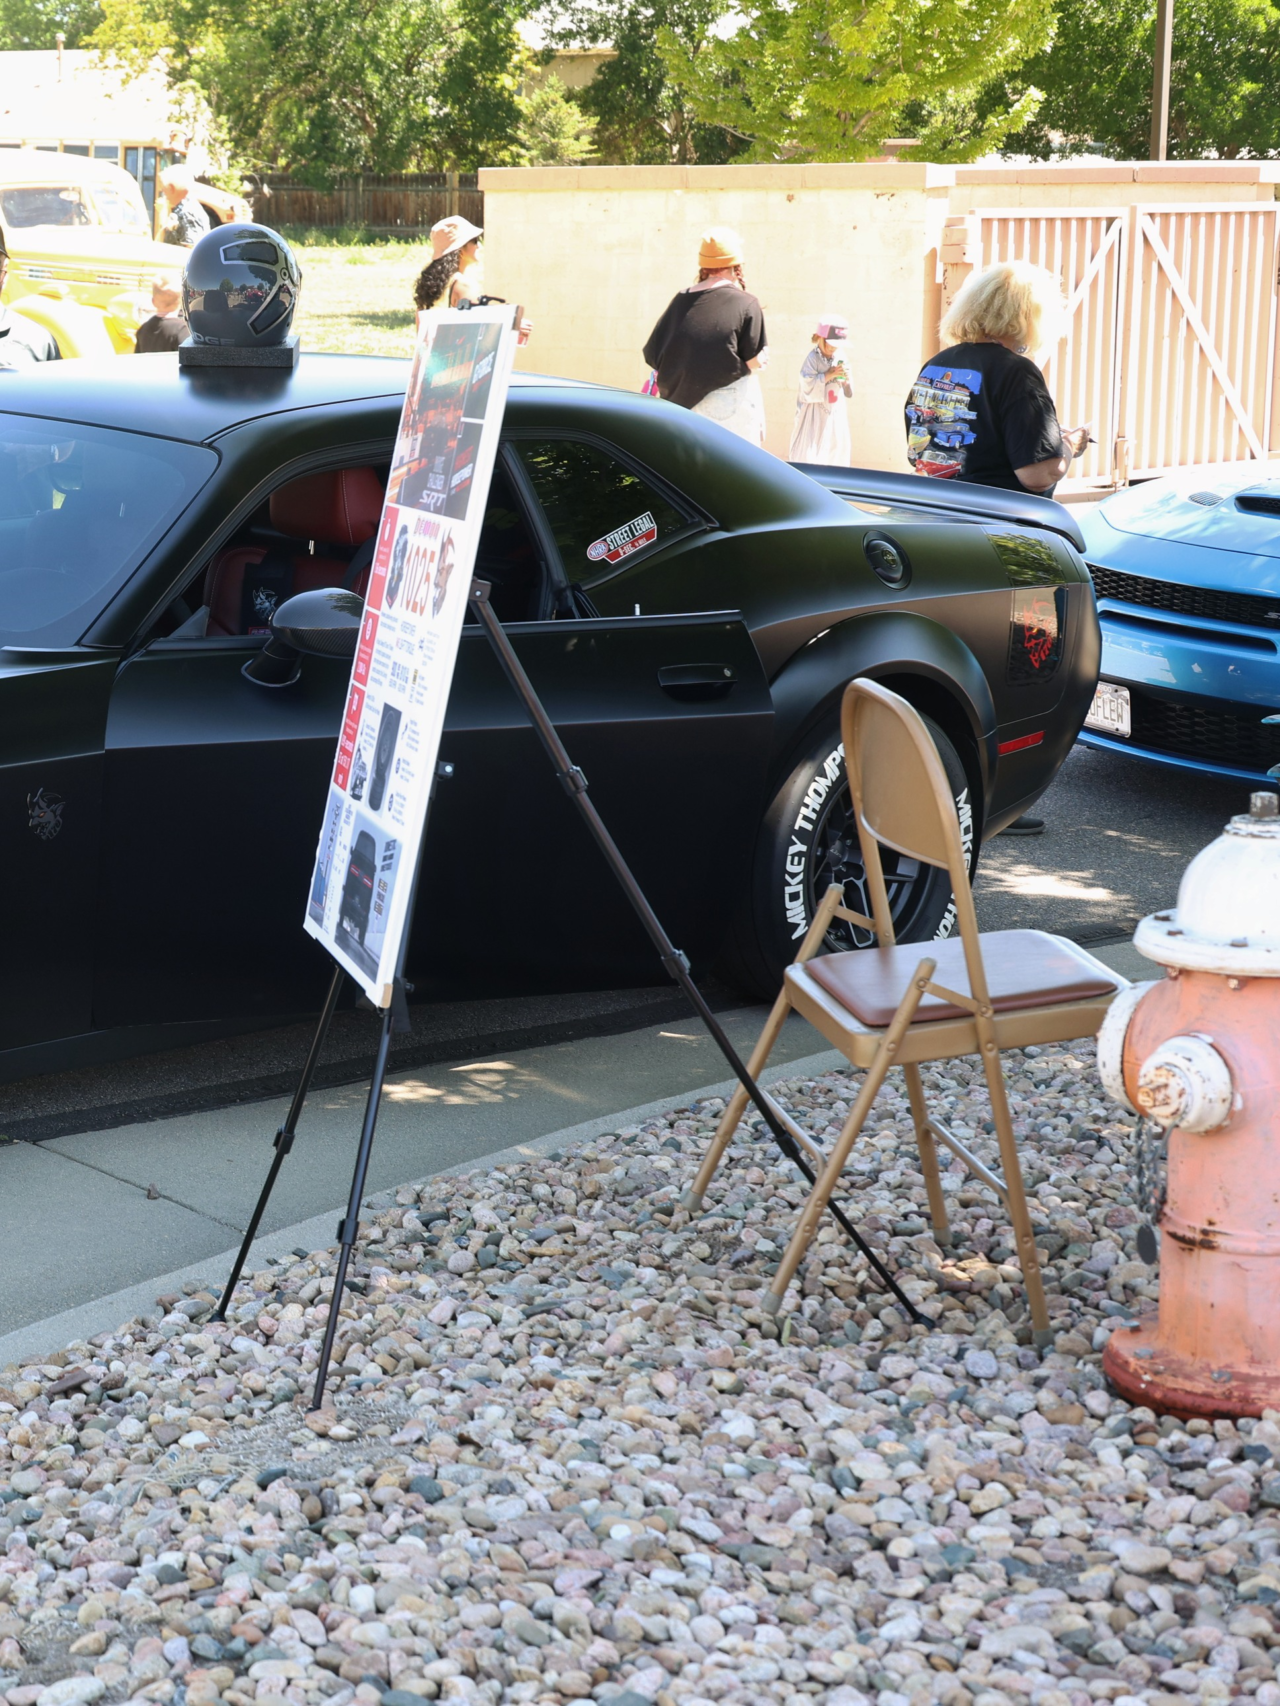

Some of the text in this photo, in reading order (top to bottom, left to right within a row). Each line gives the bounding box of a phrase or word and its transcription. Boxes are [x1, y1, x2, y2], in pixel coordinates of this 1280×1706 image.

[589, 543, 607, 557] NHRA
[606, 515, 655, 550] STREET LEGAL
[400, 543, 436, 616] 1025
[784, 742, 846, 941] MICKEY THOMP
